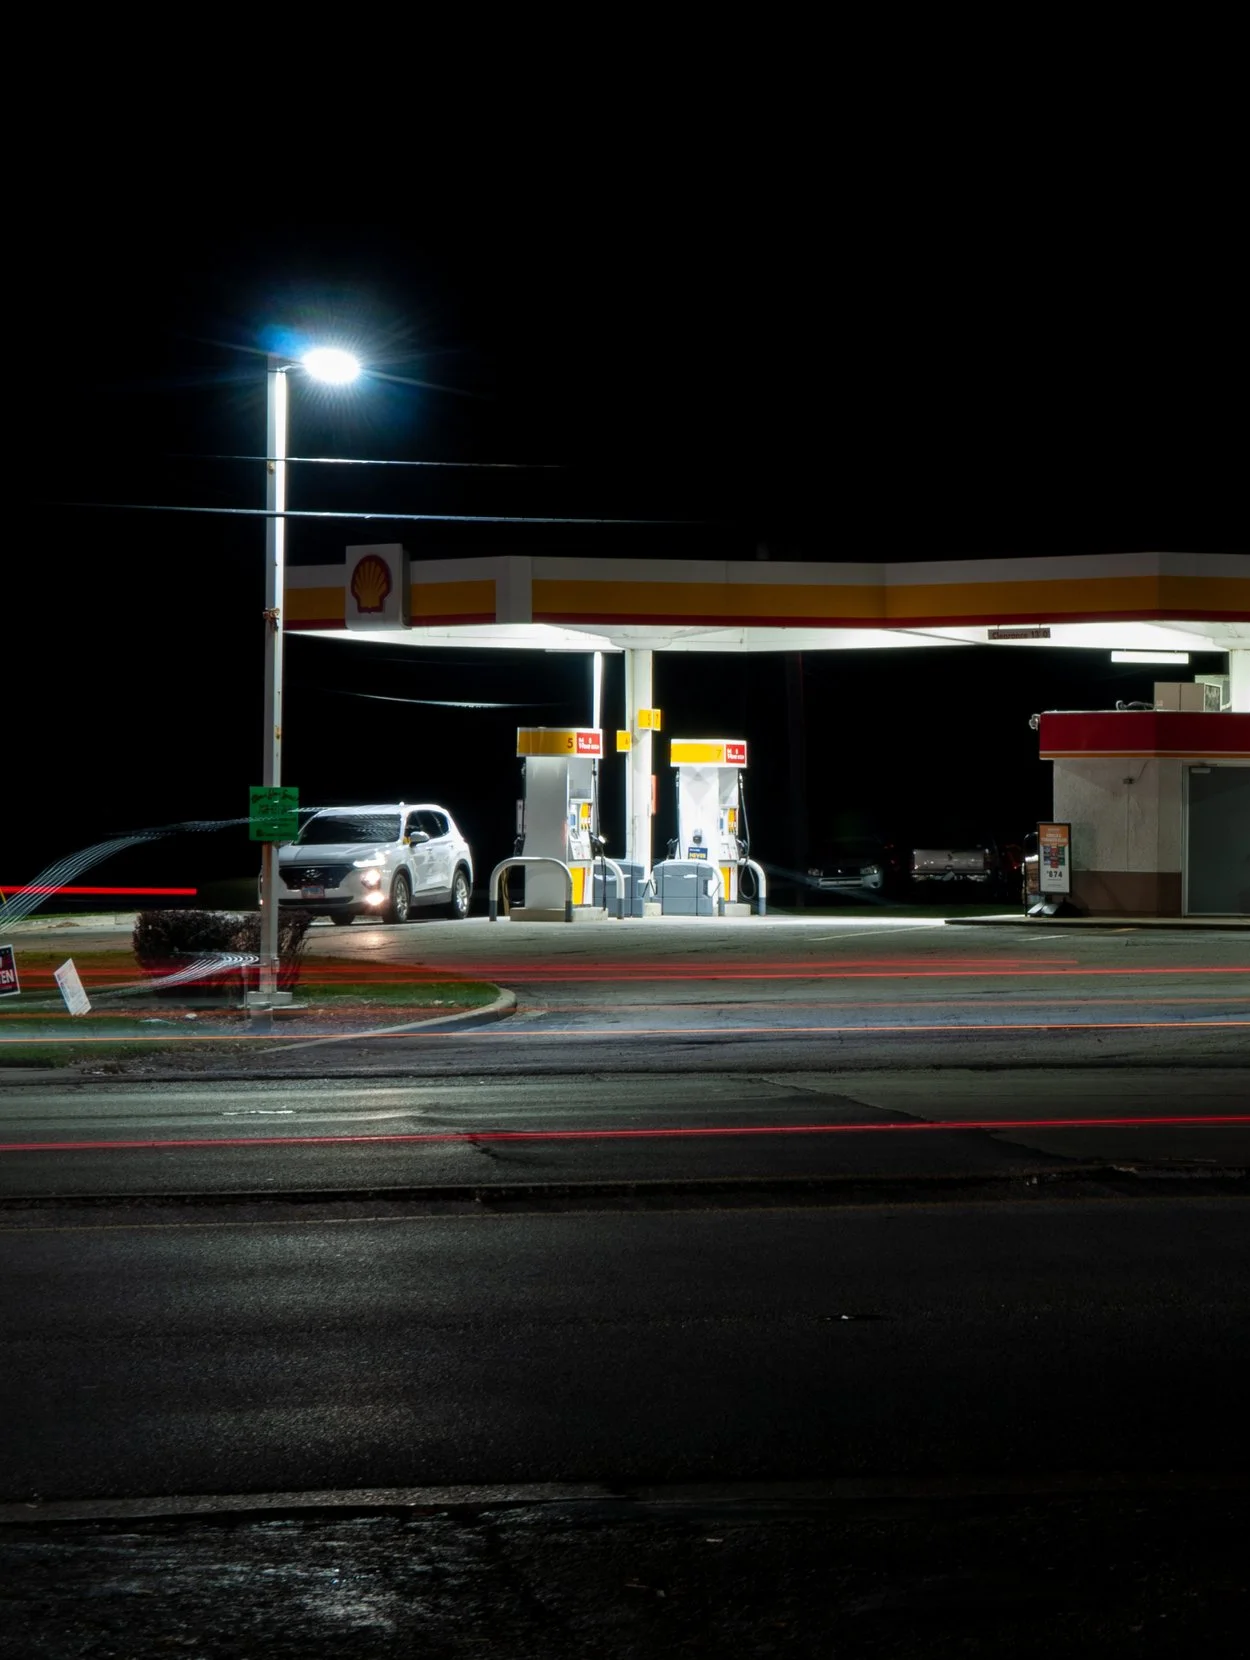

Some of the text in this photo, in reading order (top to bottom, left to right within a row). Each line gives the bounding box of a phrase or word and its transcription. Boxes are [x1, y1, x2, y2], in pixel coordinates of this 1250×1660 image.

[992, 631, 1028, 639] Clearance
[567, 737, 574, 749] 5
[715, 748, 722, 759] 7
